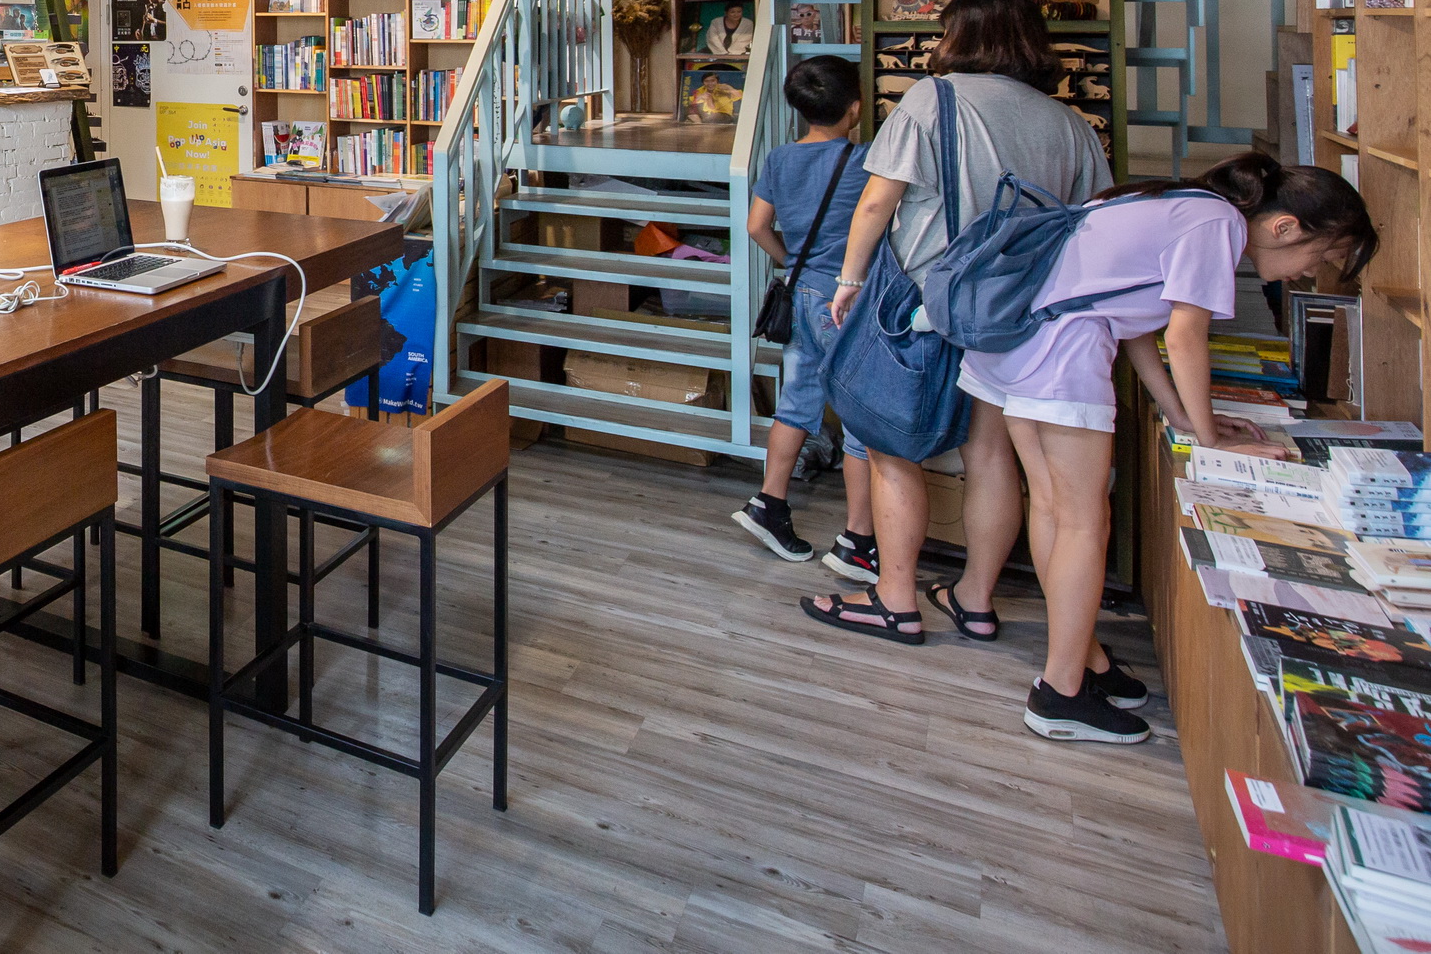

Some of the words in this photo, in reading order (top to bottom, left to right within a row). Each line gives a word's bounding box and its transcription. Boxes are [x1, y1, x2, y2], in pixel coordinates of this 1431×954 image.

[188, 121, 208, 129] Join
[168, 135, 185, 147] Pop
[205, 138, 227, 147] Asia
[185, 150, 210, 159] Now!
[407, 355, 428, 364] AMERICA
